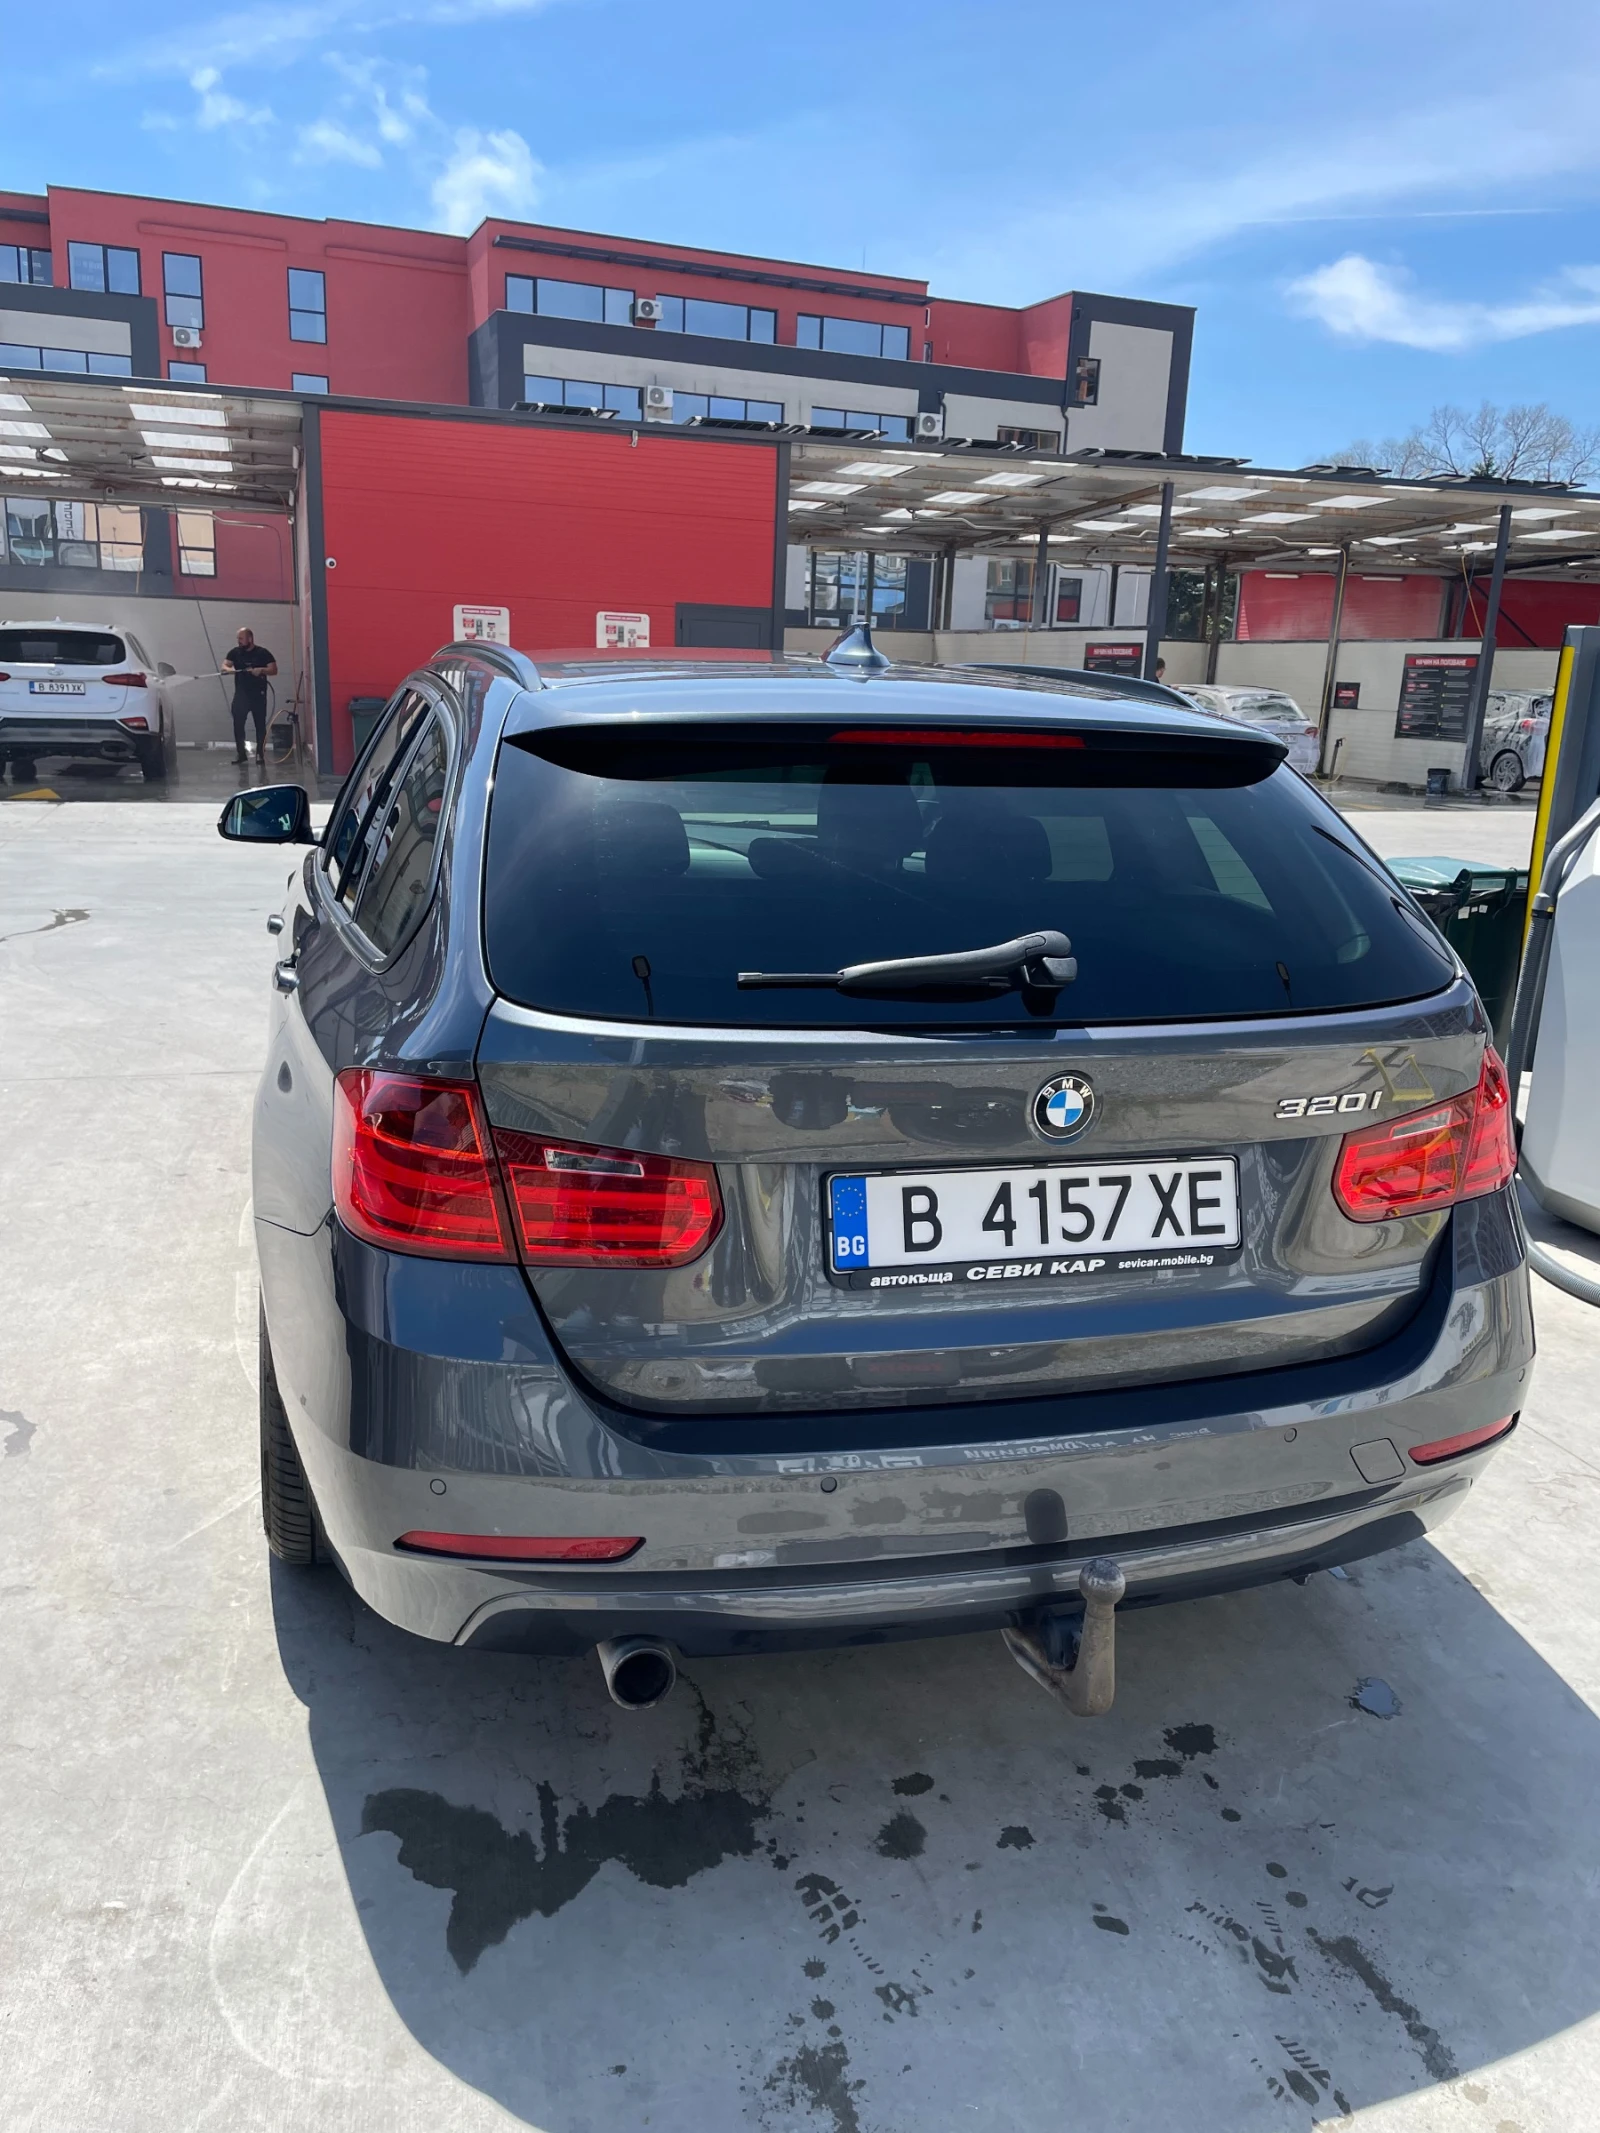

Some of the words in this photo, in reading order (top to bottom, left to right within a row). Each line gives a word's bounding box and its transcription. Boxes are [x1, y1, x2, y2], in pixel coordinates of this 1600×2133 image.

[38, 683, 45, 691] B
[49, 683, 70, 692] 8391
[72, 683, 82, 692] XK
[901, 1185, 943, 1253] B
[982, 1175, 1133, 1247] 4157
[1149, 1171, 1226, 1239] XE
[837, 1235, 865, 1257] BG
[1118, 1254, 1214, 1269] sevicar.mobile.bg
[870, 1272, 953, 1287] автокъща
[967, 1263, 1042, 1280] СЕВИ
[1050, 1259, 1106, 1274] КАР
